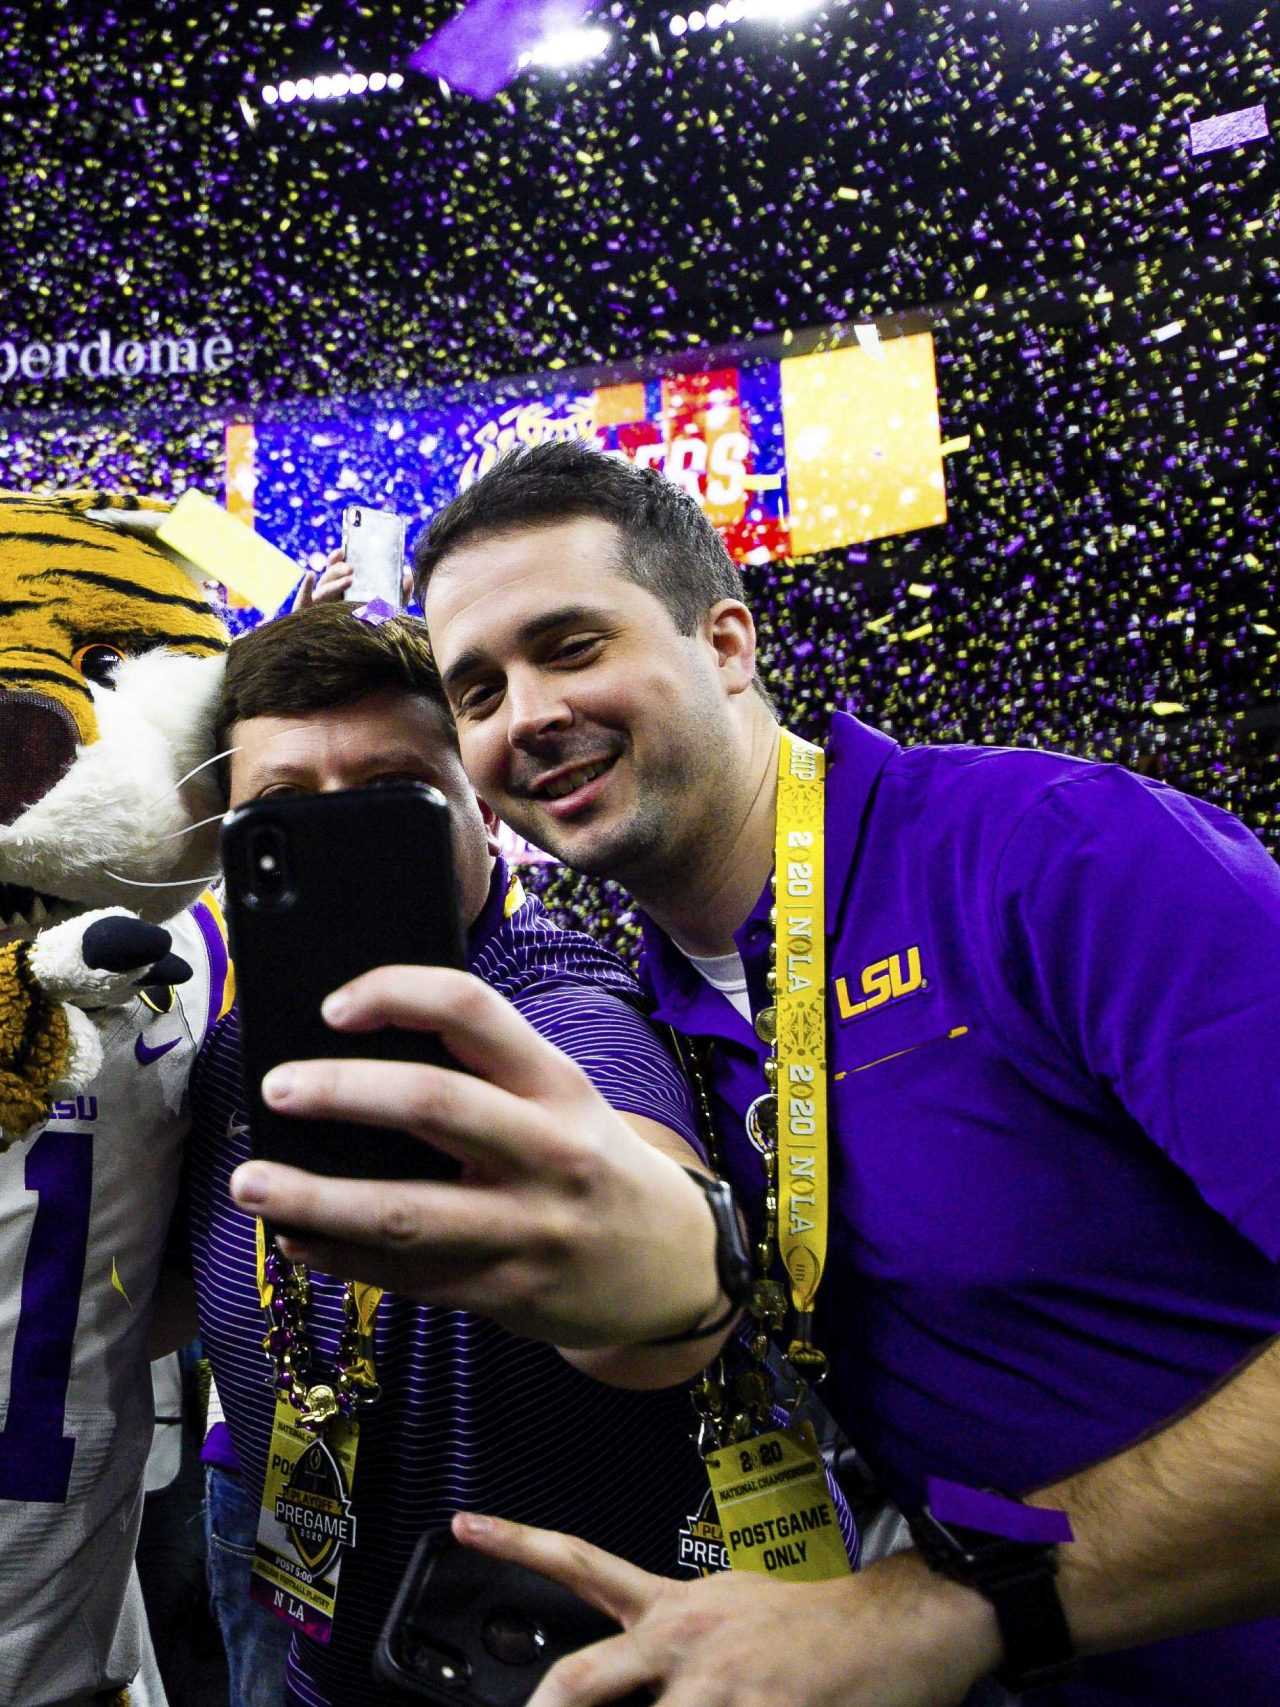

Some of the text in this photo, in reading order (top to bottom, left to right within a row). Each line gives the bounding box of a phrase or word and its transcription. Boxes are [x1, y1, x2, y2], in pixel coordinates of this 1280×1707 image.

[785, 915, 815, 995] NOLA
[833, 946, 923, 1022] LSU
[787, 1157, 817, 1237] NOLA
[719, 1480, 755, 1500] NATIONAL
[276, 1501, 348, 1540] PREGAME
[728, 1503, 832, 1551] POSTGAME
[275, 1556, 295, 1574] POST
[763, 1540, 808, 1571] ONLY
